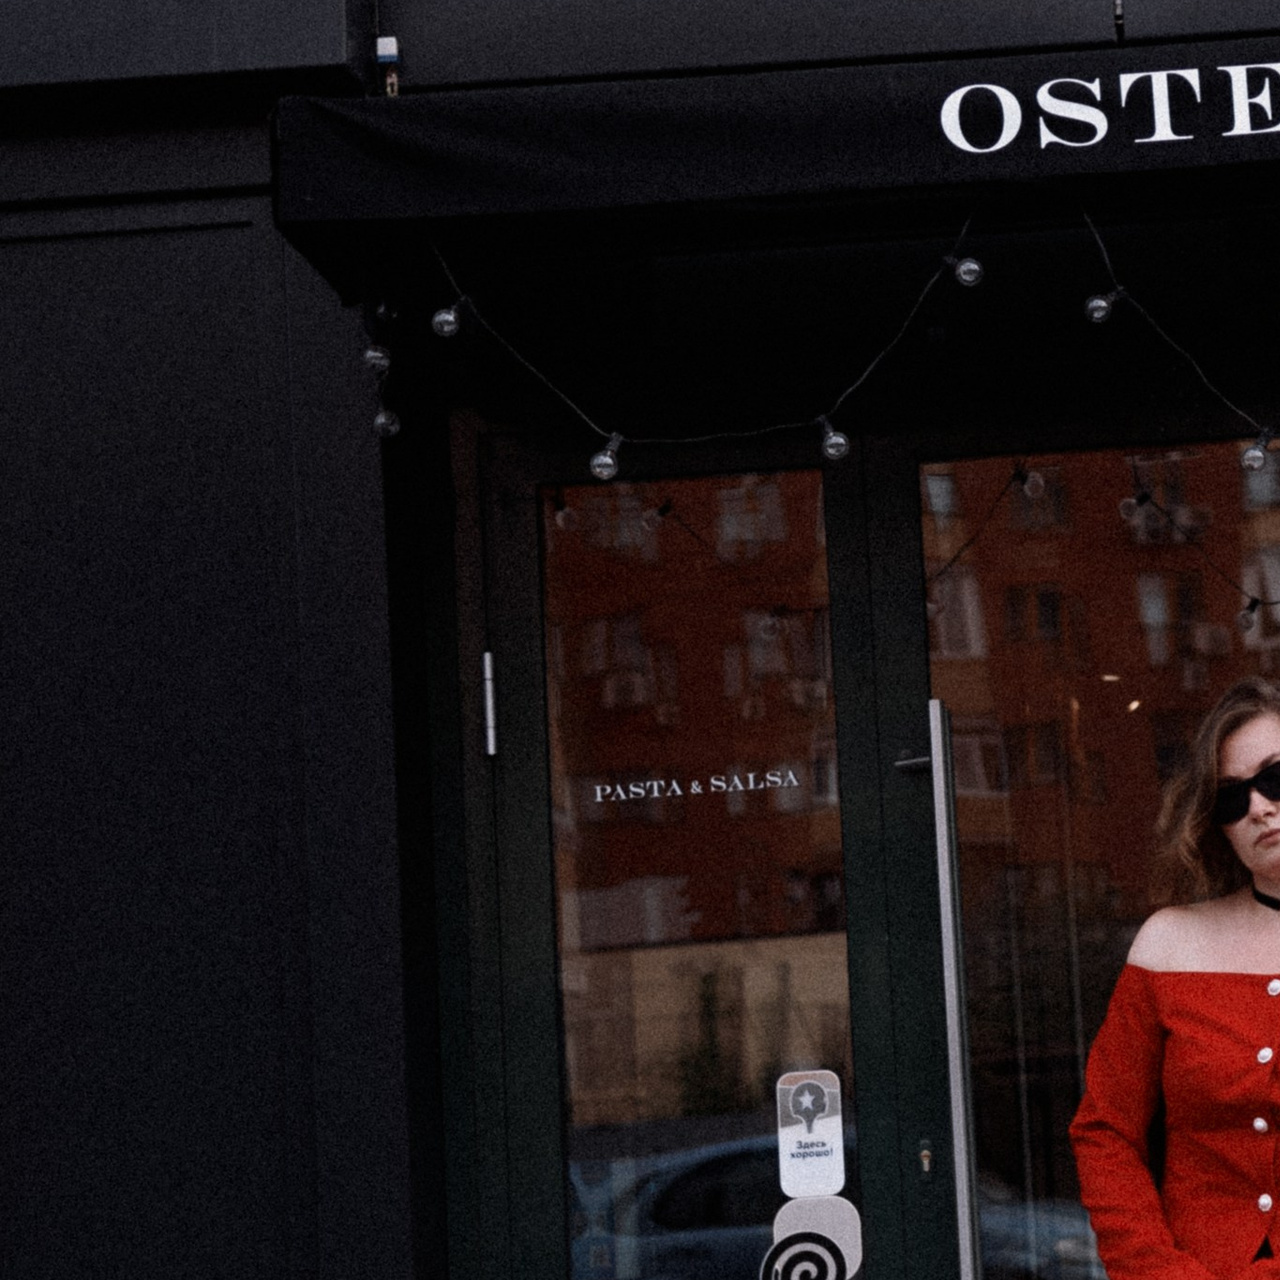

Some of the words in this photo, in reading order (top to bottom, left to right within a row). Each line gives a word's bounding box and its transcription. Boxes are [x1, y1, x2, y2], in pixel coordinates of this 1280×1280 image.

[594, 779, 683, 803] PASTA
[690, 780, 704, 795] &
[710, 769, 800, 793] SALSA
[796, 1140, 827, 1150] Здесь
[790, 1147, 833, 1160] хорошо!
